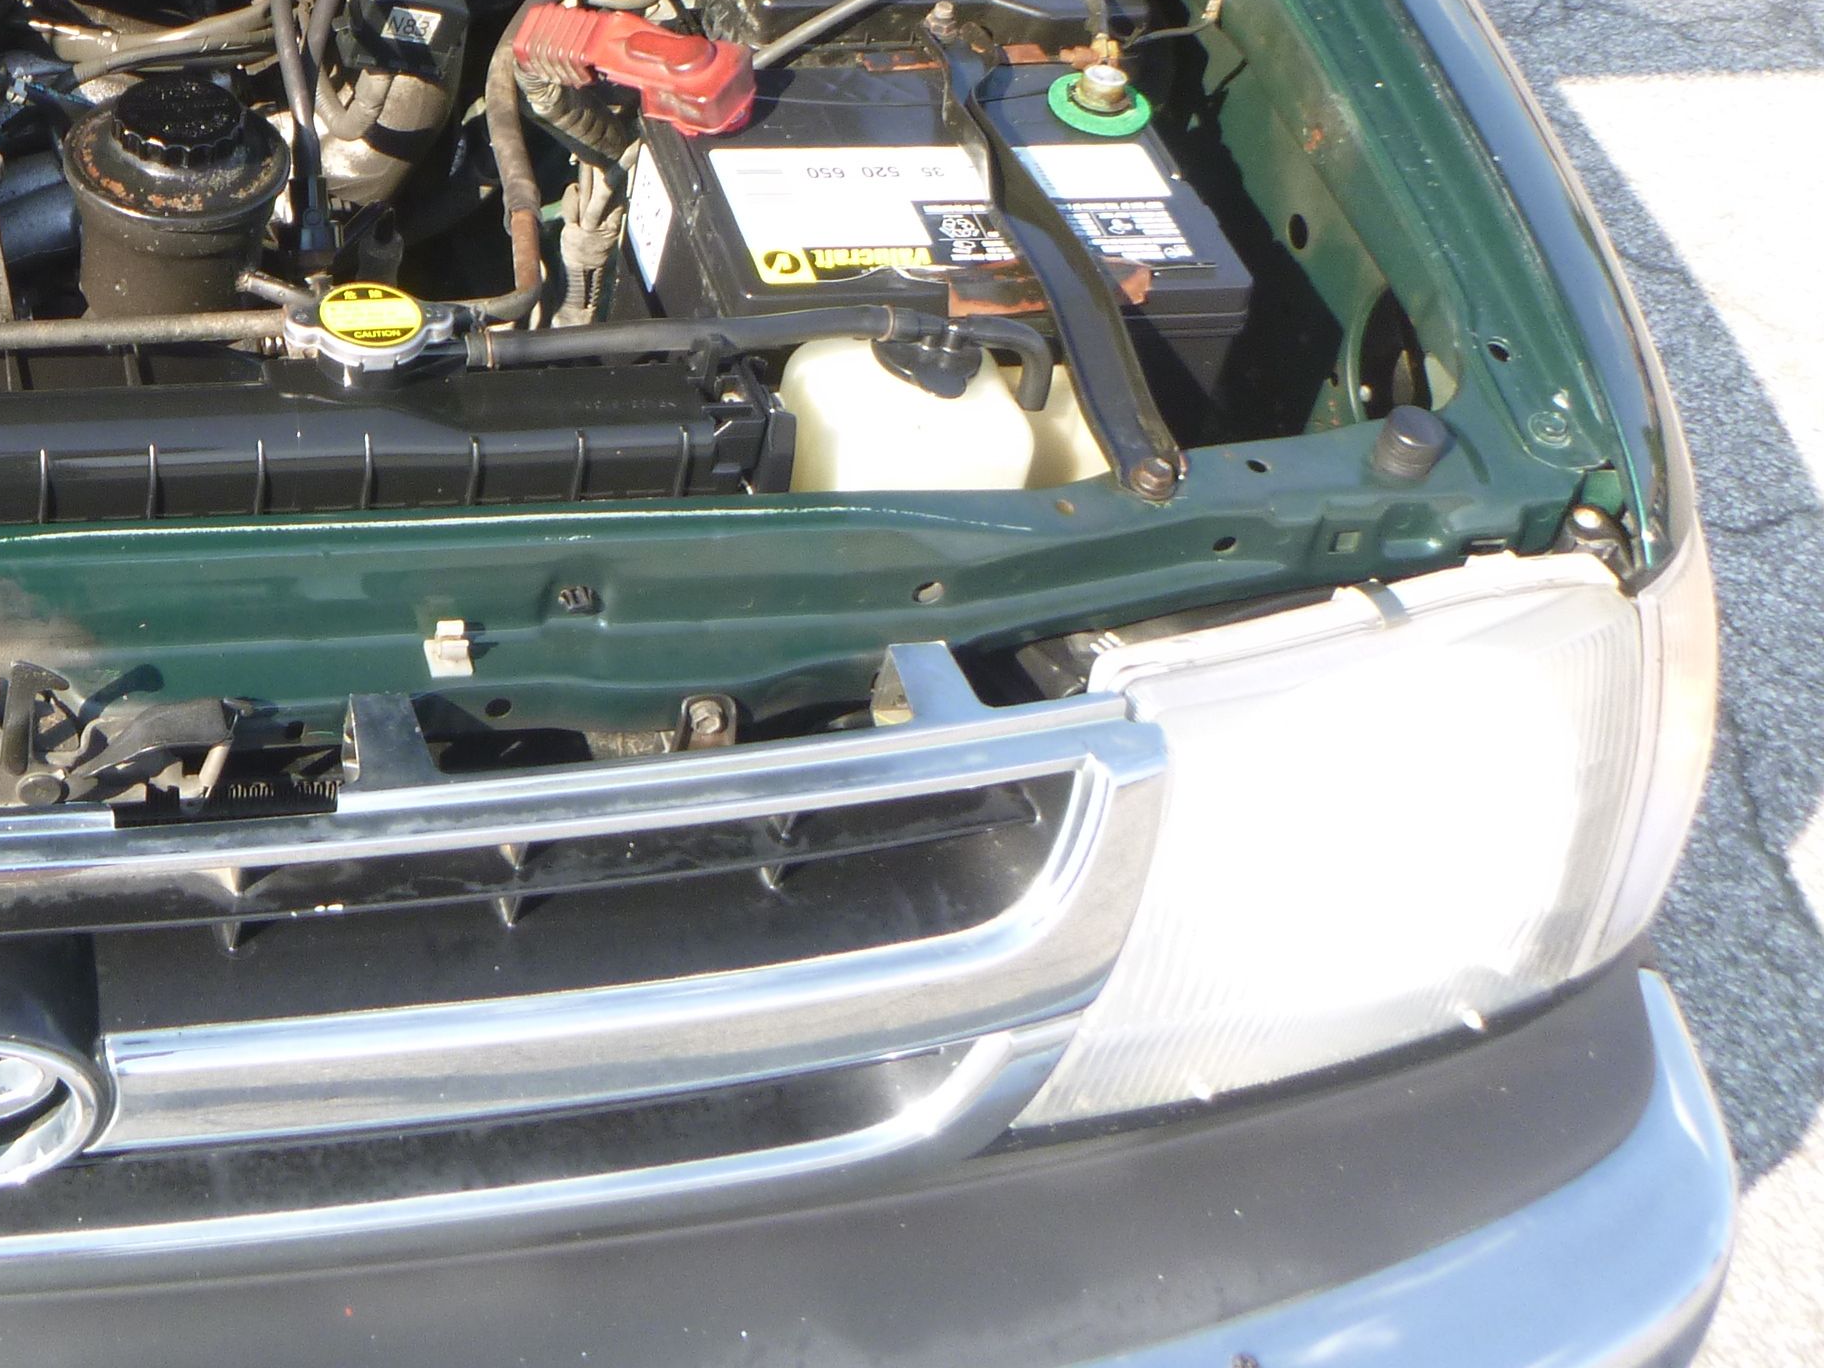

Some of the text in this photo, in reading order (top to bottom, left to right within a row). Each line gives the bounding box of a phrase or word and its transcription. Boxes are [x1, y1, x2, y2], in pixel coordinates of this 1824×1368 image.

[386, 16, 430, 37] N83
[806, 165, 945, 179] 35 520 650
[354, 329, 401, 339] CAUTION
